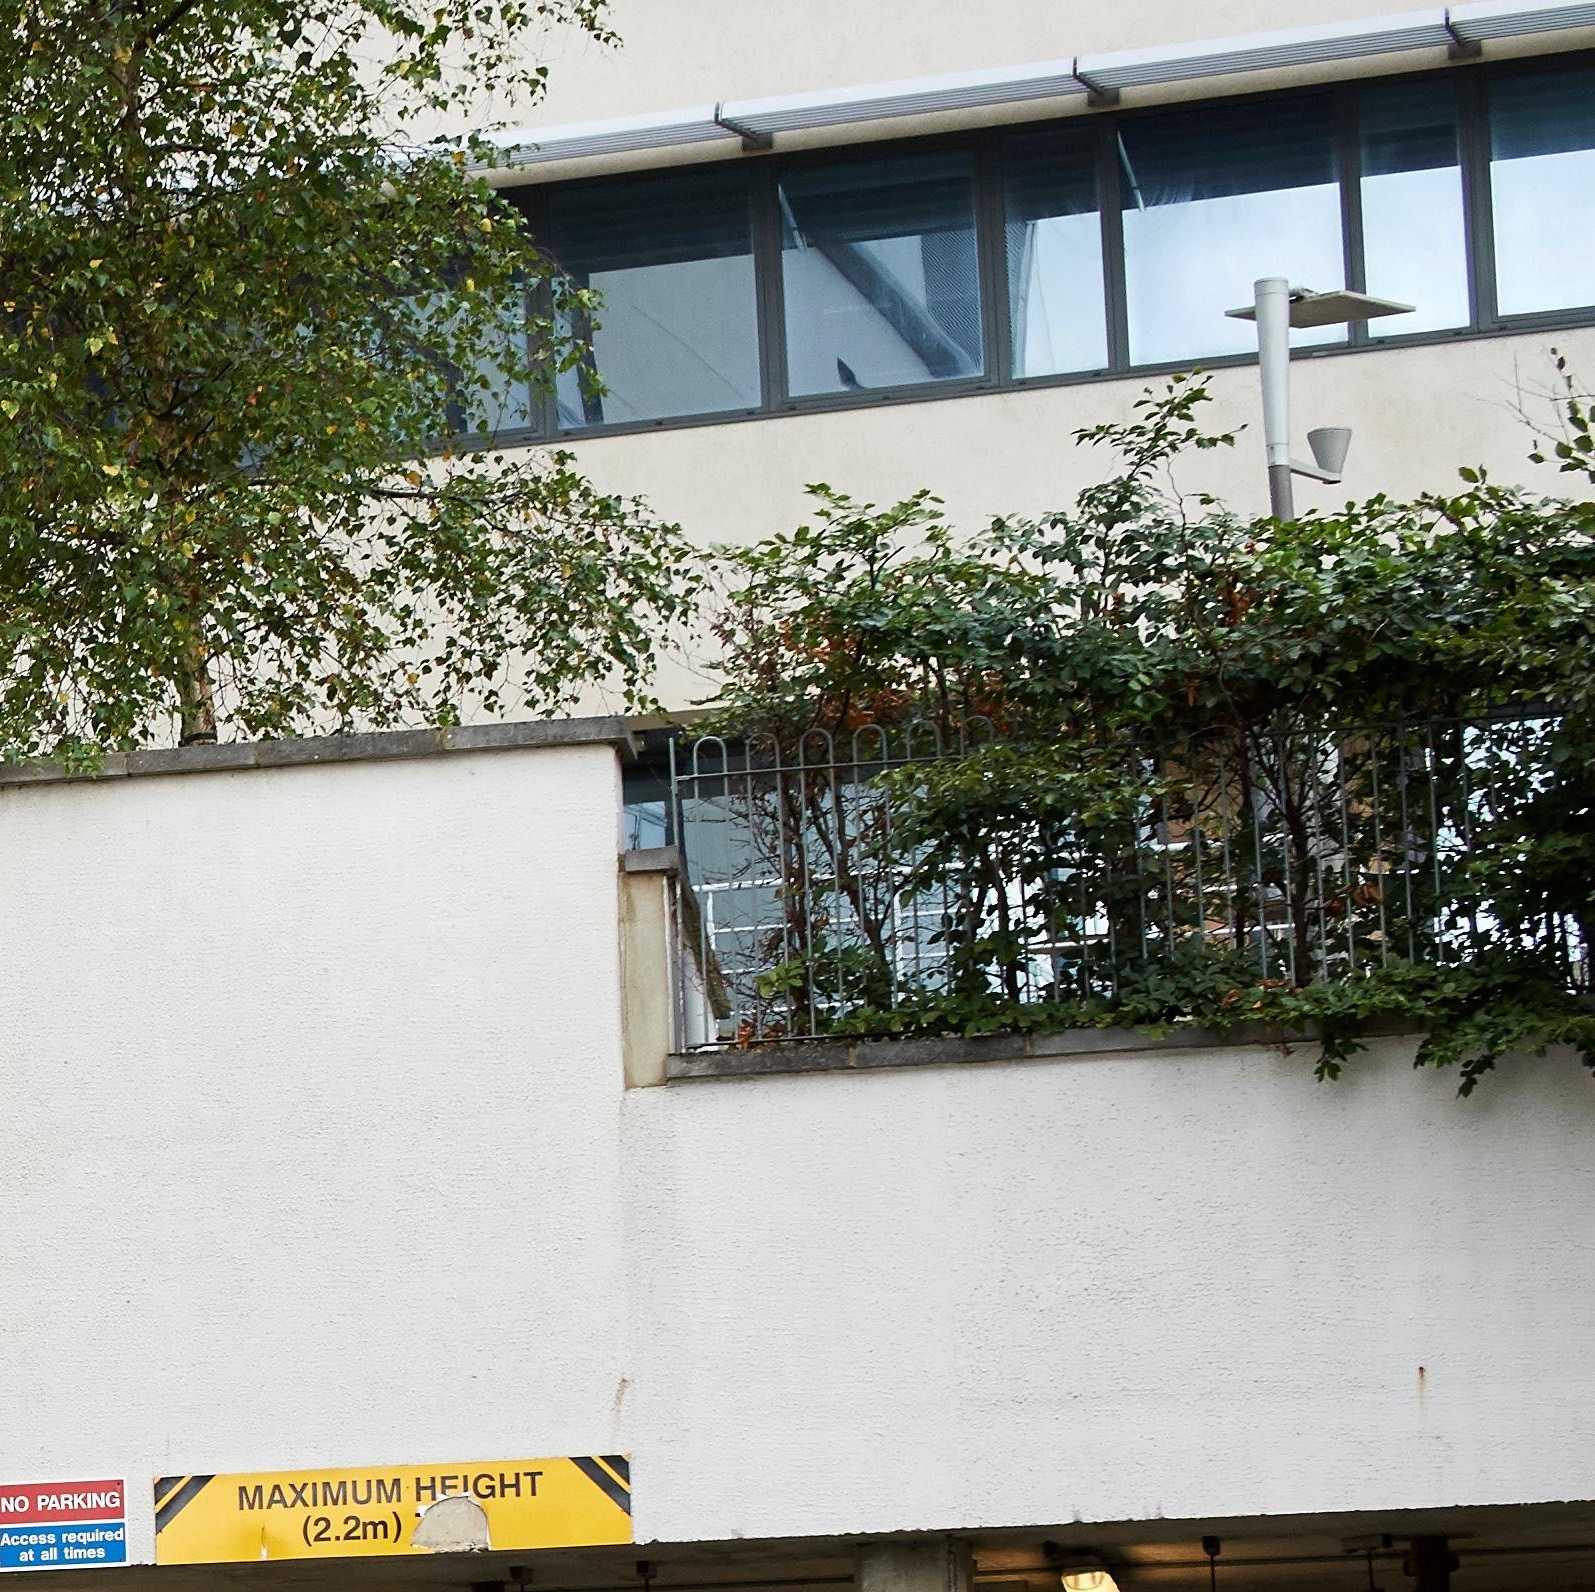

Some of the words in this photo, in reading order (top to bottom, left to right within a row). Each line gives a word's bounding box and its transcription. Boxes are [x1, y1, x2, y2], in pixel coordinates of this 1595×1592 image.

[1, 1496, 29, 1513] NO
[37, 1491, 121, 1512] PARKING
[238, 1478, 401, 1511] MAXIMUM
[0, 1532, 55, 1547] Access
[62, 1528, 124, 1545] required
[302, 1511, 402, 1547] (2.2m)
[19, 1549, 34, 1562] at
[41, 1547, 57, 1561] all
[64, 1546, 105, 1560] times
